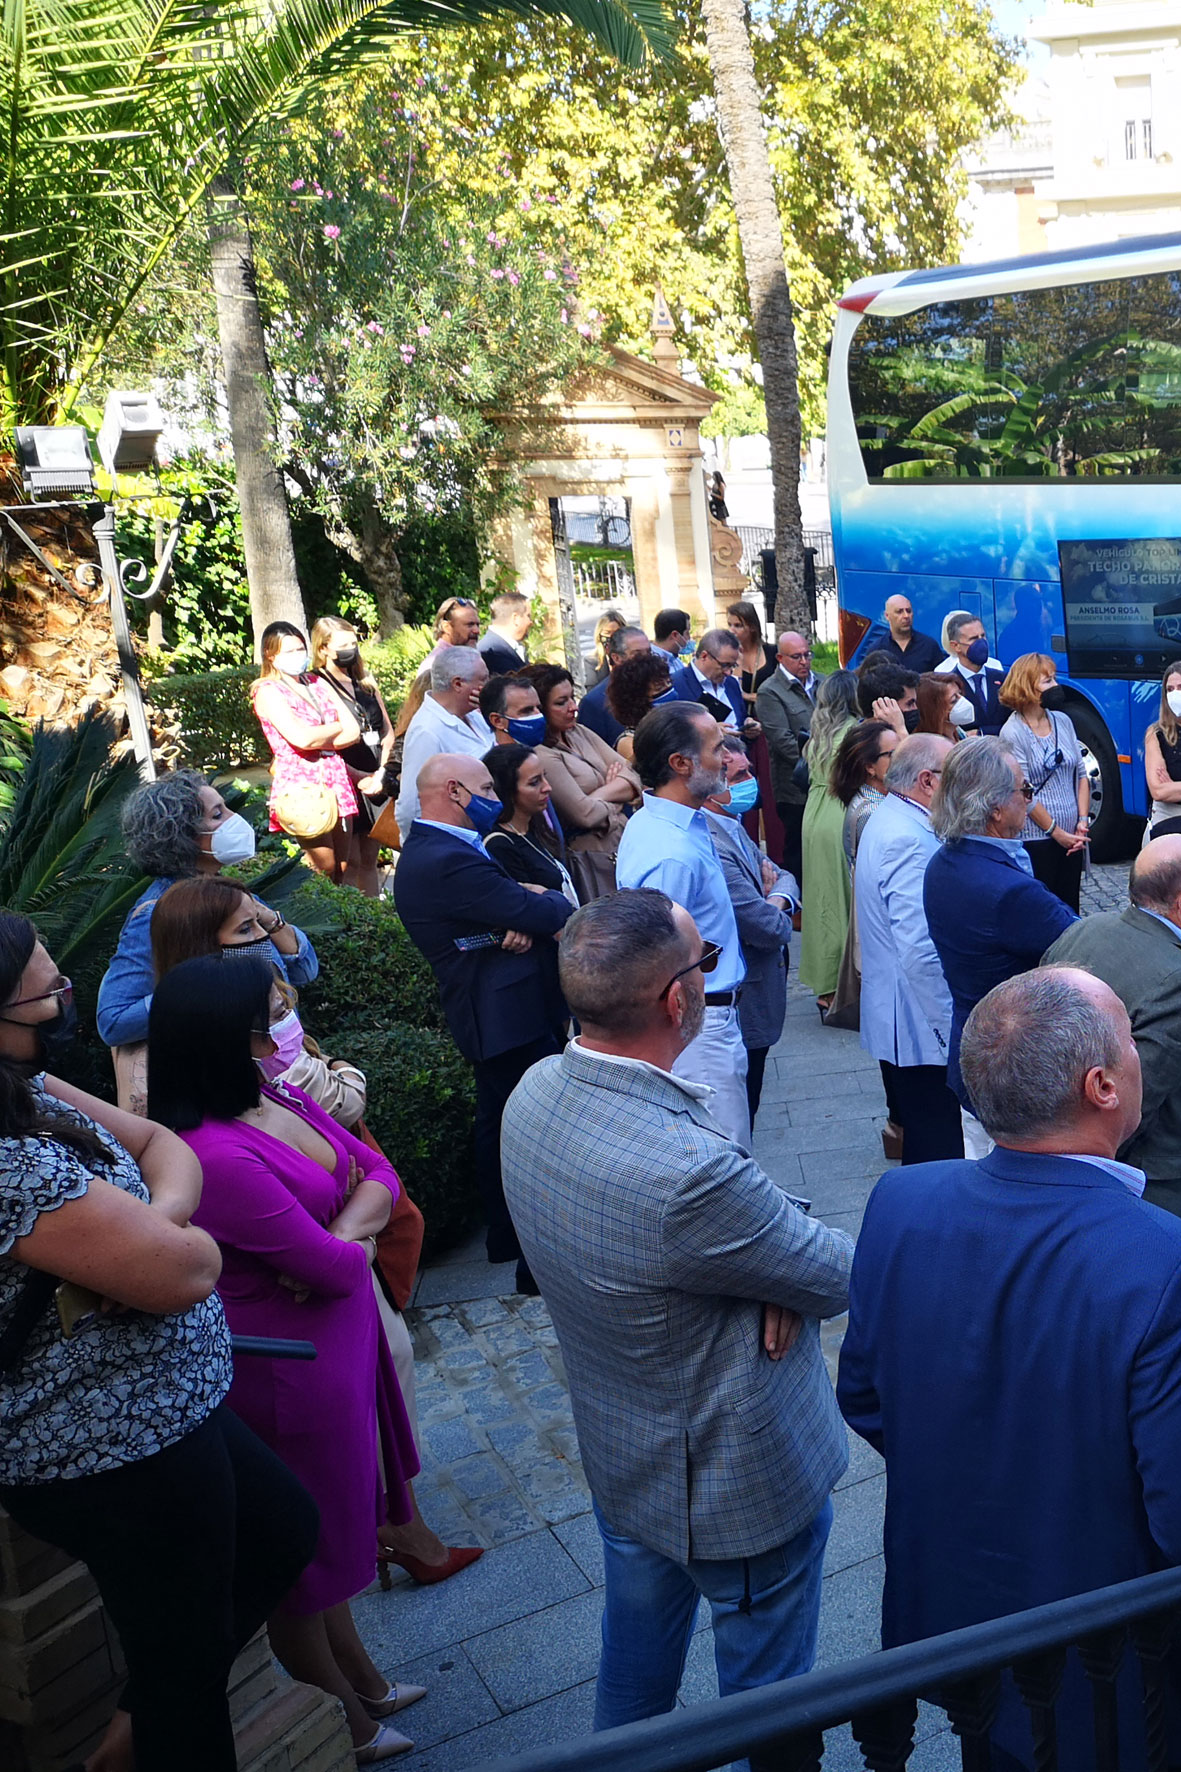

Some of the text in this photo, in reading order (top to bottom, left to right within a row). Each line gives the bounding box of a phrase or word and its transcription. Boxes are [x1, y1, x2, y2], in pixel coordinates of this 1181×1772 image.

[1146, 548, 1166, 557] TOP
[1087, 560, 1131, 572] TECHO
[1120, 574, 1136, 584] DE
[1078, 606, 1140, 614] ANSELMO ROSA
